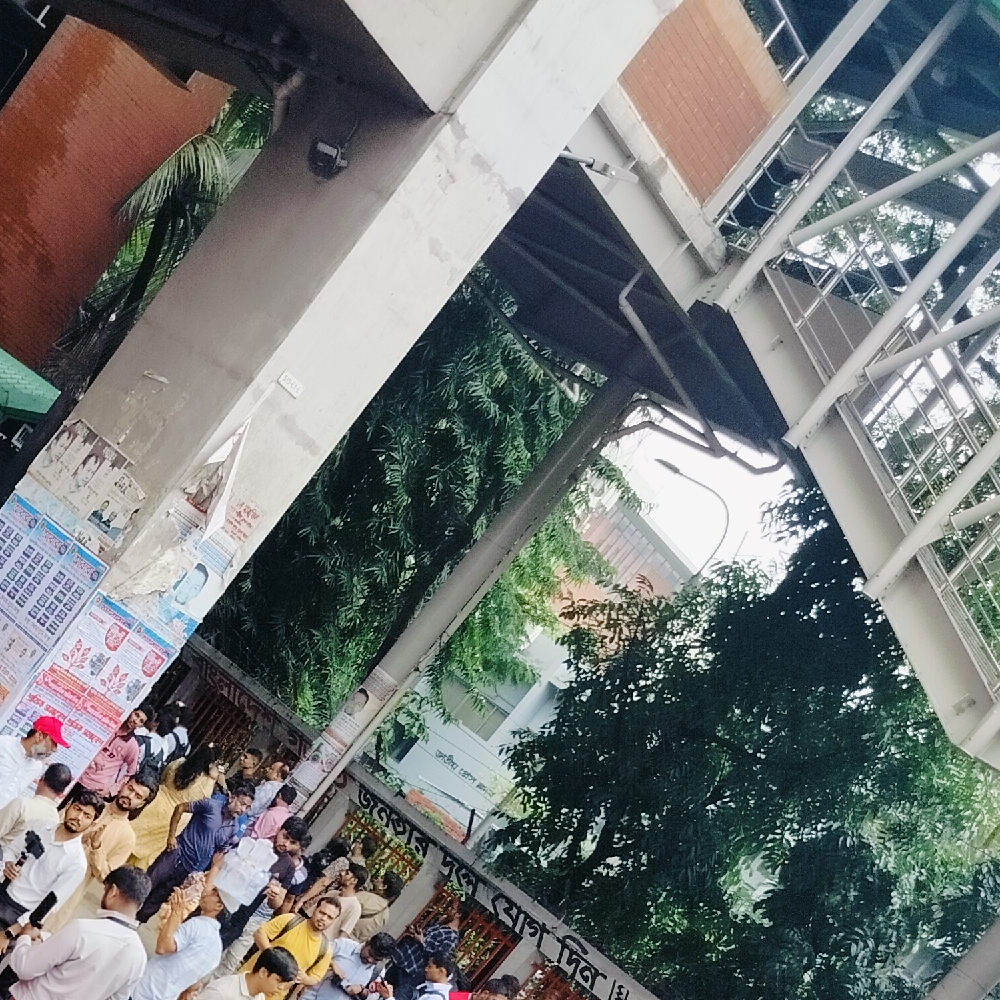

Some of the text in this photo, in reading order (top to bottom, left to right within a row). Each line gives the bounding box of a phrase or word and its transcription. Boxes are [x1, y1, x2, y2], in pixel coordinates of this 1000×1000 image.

[358, 784, 437, 859] জনতার
[491, 892, 552, 950] যোগ
[556, 934, 607, 991] দিন
